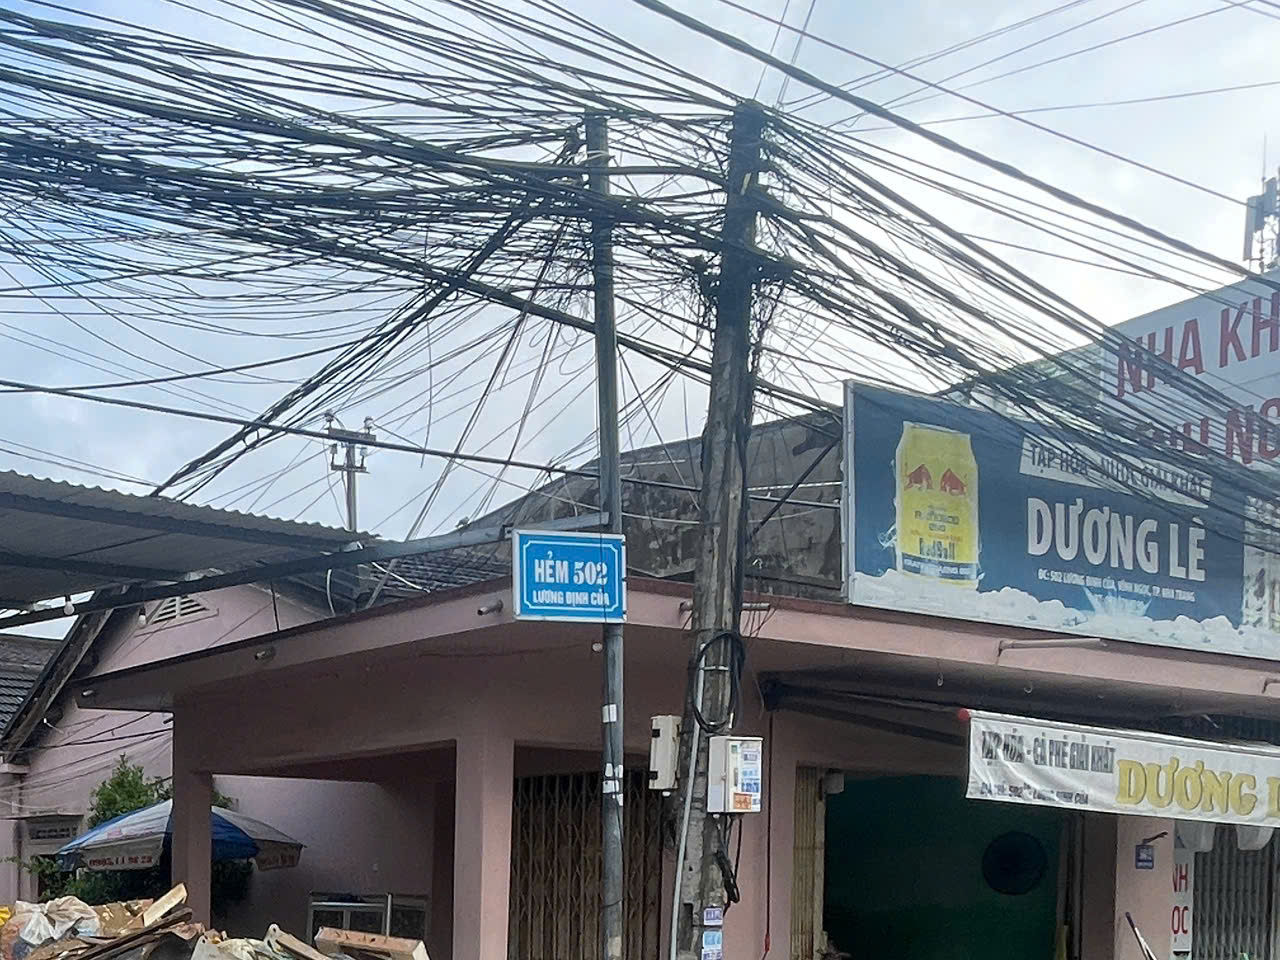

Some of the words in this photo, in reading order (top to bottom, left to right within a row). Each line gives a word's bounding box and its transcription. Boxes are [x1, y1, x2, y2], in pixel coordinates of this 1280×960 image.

[1028, 498, 1159, 573] DƯƠNG
[534, 550, 569, 584] HẺM
[574, 561, 608, 586] 502
[1116, 757, 1257, 815] DƯƠNG
